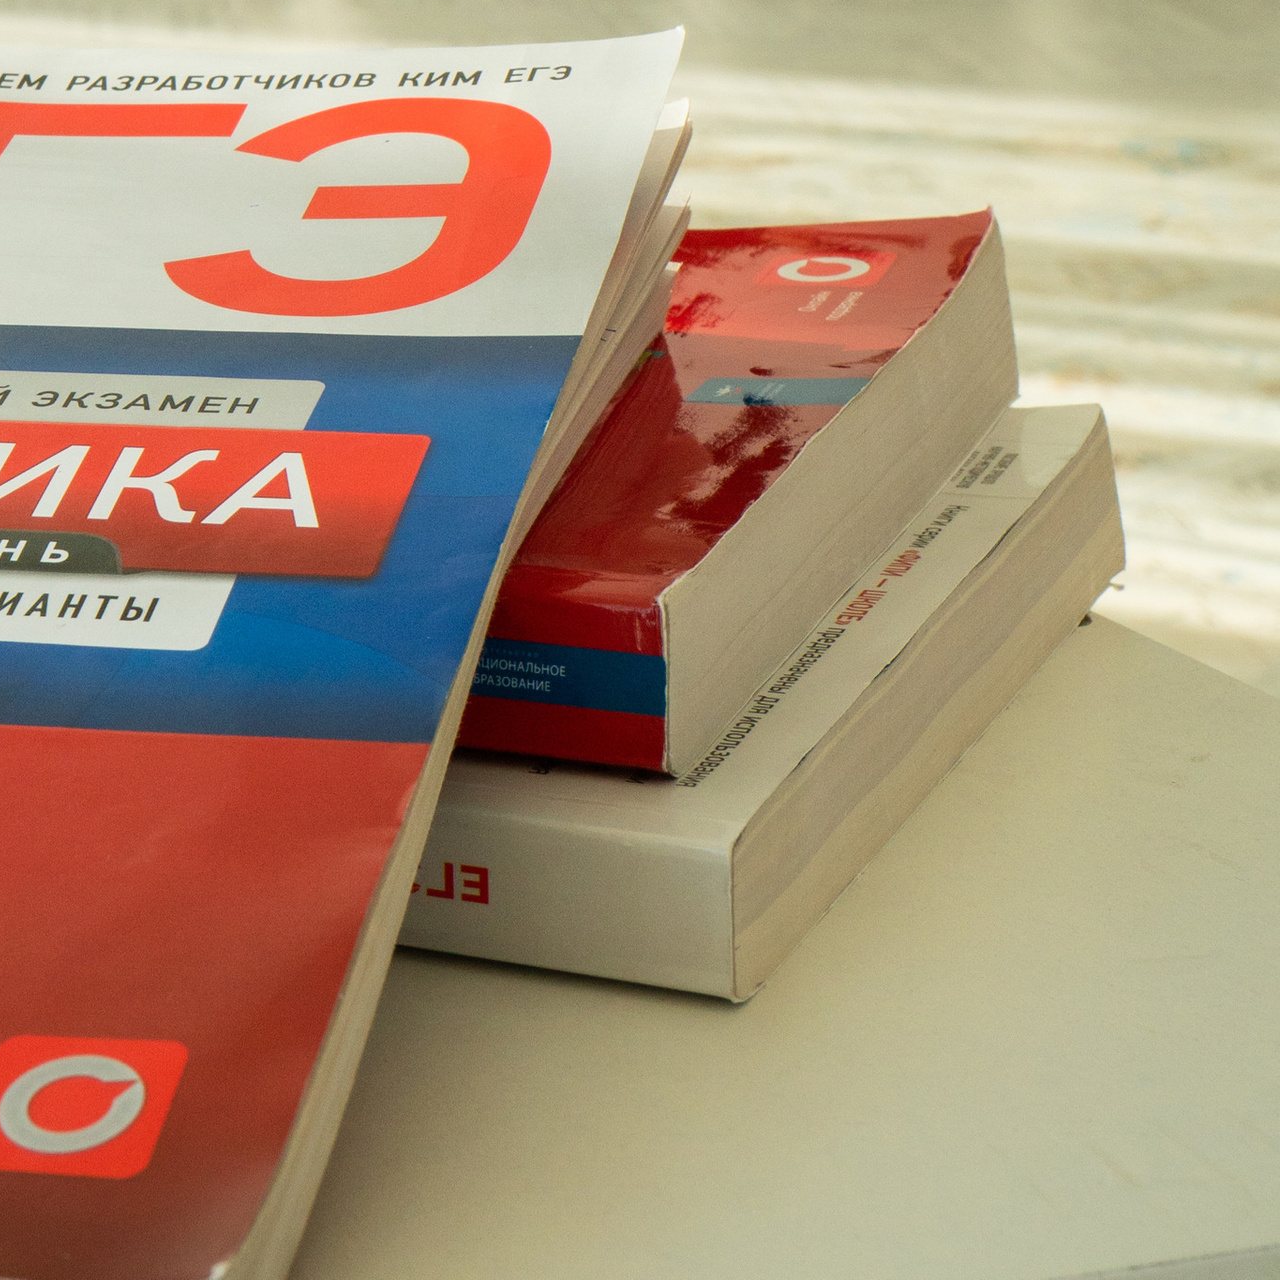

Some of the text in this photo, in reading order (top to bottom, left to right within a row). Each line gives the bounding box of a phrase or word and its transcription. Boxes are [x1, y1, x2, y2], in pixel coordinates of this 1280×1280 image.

[65, 72, 377, 93] РАЗРАБОТЧИКОВ
[398, 69, 483, 88] КИМ
[503, 65, 573, 85] ЕГЭ
[30, 390, 260, 415] ЭКЗАМЕН
[477, 656, 566, 678] ЦИОНАЛЬНОЕ
[767, 627, 846, 695] предназначены
[473, 672, 551, 692] БРАЗОВАНИЕ
[748, 695, 780, 715] для
[675, 716, 762, 788] использования
[412, 861, 490, 905] ЕГ
